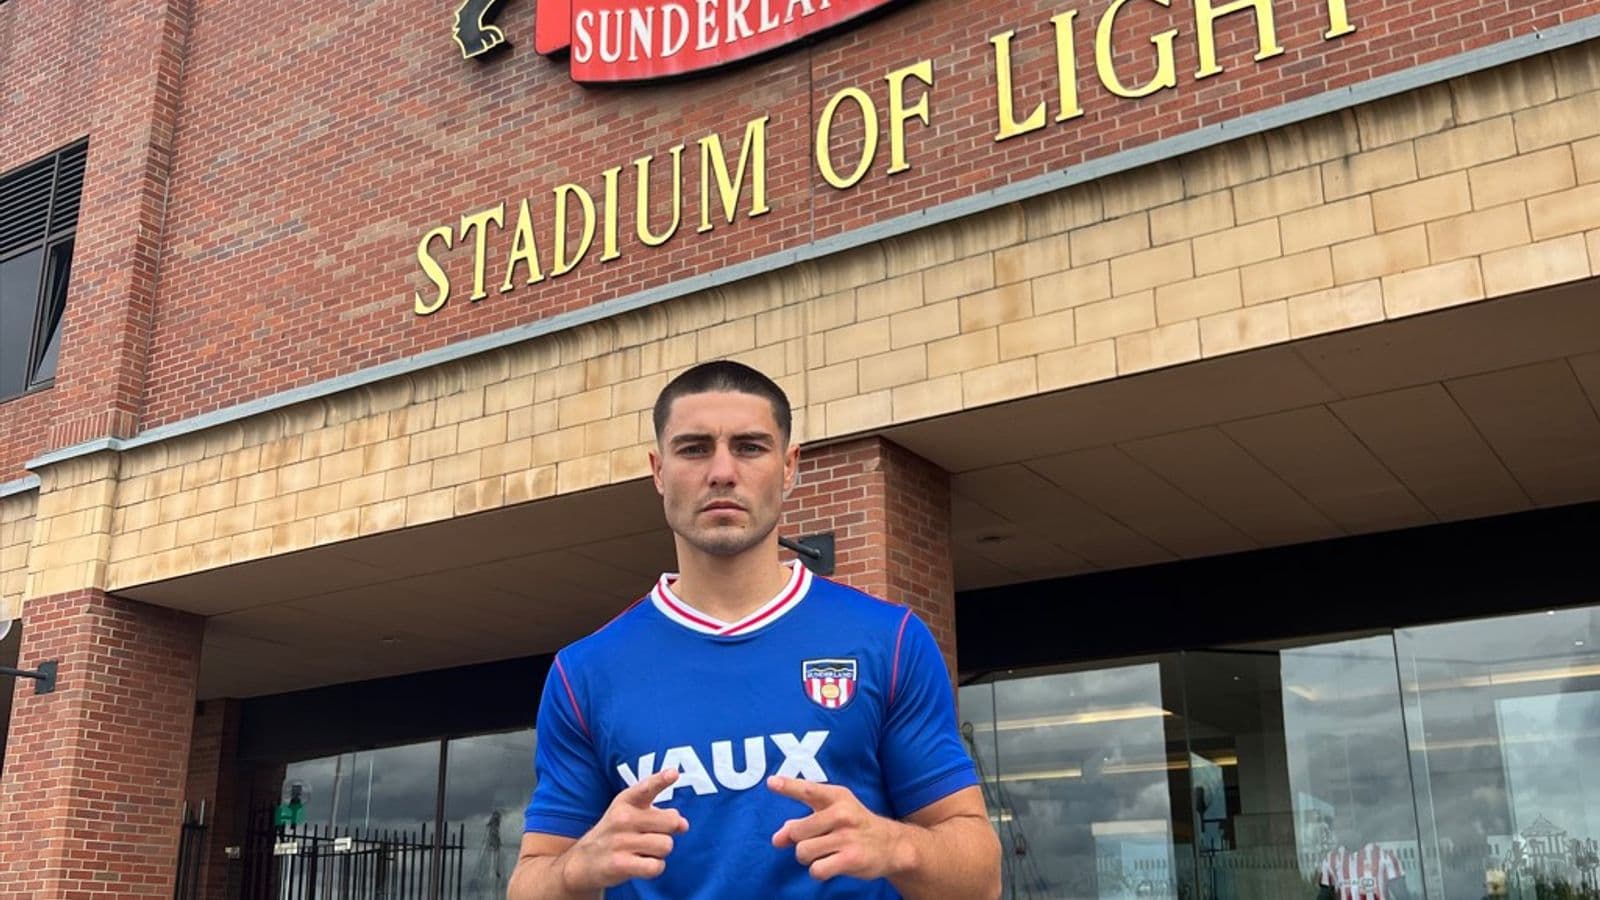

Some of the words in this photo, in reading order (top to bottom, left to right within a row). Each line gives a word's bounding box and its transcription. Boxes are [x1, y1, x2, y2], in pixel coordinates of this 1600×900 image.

[574, 0, 831, 63] SUNDERL
[413, 115, 770, 316] STADIUM
[815, 59, 934, 189] OF
[616, 730, 829, 803] VAUX
